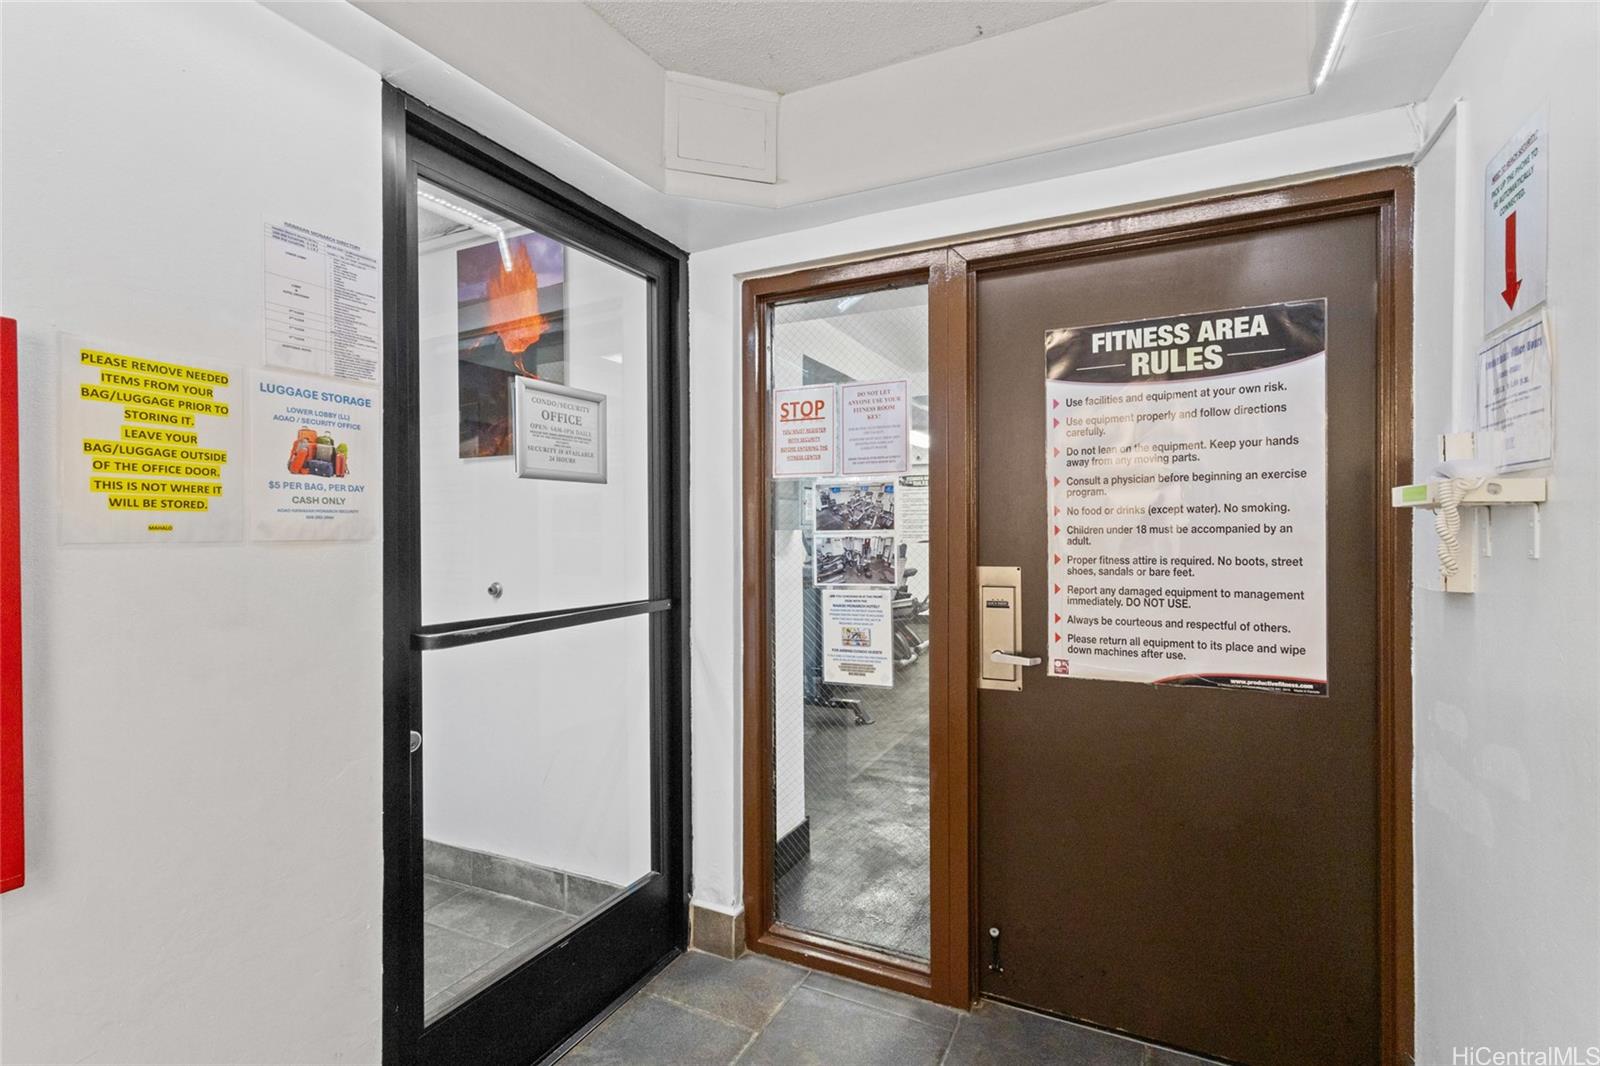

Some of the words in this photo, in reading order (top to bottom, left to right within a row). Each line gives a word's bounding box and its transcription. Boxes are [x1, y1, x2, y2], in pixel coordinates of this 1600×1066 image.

[1092, 323, 1190, 353] FITNESS
[1198, 314, 1269, 342] AREA
[81, 352, 128, 368] PLEASE
[131, 361, 183, 377] REMOVE
[186, 370, 229, 384] NEEDED
[1131, 345, 1223, 376] RULES
[101, 373, 141, 387] ITEMS
[143, 379, 179, 392] FROM
[182, 385, 214, 397] YOUR
[81, 387, 175, 407] BAG/LUGGAGE
[178, 400, 212, 412] PRIOR
[213, 405, 229, 415] TO
[260, 383, 319, 400] LUGGAGE
[321, 392, 371, 407] STORAGE
[1066, 398, 1083, 408] Use
[1084, 395, 1124, 407] facilities
[1125, 392, 1144, 403] and
[1146, 389, 1198, 402] equipment
[1200, 388, 1211, 397] at
[1213, 387, 1236, 398] your
[1238, 385, 1261, 394] own
[1264, 381, 1287, 392] risk.
[531, 397, 589, 412] CONDO/SECURITY
[780, 400, 825, 418] STOP
[124, 410, 178, 424] STORING
[181, 416, 194, 426] IT.
[286, 407, 314, 416] LOWER
[314, 410, 337, 419] LOBBY
[541, 410, 582, 426] OFFICE
[273, 414, 295, 422] AOAO
[300, 417, 336, 427] SECURITY
[337, 422, 361, 430] OFFICE
[124, 429, 162, 441] LEAVE
[165, 433, 198, 444] YOUR
[84, 442, 177, 458] BAG/LUGGAGE
[180, 450, 227, 462] OUTSIDE
[92, 460, 110, 470] OF
[113, 461, 138, 472] THE
[141, 464, 182, 474] OFFICE
[185, 466, 220, 477] DOOR.
[1066, 476, 1101, 486] Consult
[1103, 477, 1109, 485] a
[1111, 474, 1156, 486] physician
[1158, 473, 1190, 483] before
[1192, 471, 1242, 483] beginning
[1245, 472, 1258, 480] an
[1261, 469, 1307, 479] exercise
[93, 480, 123, 490] THIS
[127, 482, 138, 491] IS
[141, 482, 168, 492] NOT
[170, 484, 210, 494] WHERE
[213, 486, 222, 494] IT
[268, 480, 281, 490] $5
[283, 481, 302, 490] PER
[304, 482, 327, 492] BAG,
[328, 484, 347, 492] PER
[347, 484, 365, 493] DAY
[108, 498, 140, 508] WILL
[143, 499, 157, 508] BE
[160, 499, 208, 509] STORED.
[292, 496, 320, 504] CASH
[321, 497, 346, 505] ONLY
[1066, 525, 1104, 535] Children
[1106, 525, 1134, 534] under
[1136, 524, 1147, 534] 18
[1149, 525, 1173, 534] must
[1176, 525, 1189, 534] be
[1191, 524, 1261, 535] accompanied
[1264, 523, 1277, 535] by
[1279, 525, 1293, 533] an
[1067, 536, 1091, 546] adult.
[1067, 555, 1097, 566] Proper
[1099, 555, 1131, 565] fitness
[1132, 556, 1157, 565] attire
[1160, 555, 1168, 566] is
[1170, 556, 1214, 567] required.
[1218, 556, 1232, 566] No
[1235, 556, 1268, 567] boots,
[1271, 557, 1303, 567] street
[1067, 567, 1096, 576] shoes,
[1098, 566, 1134, 576] sandals
[1136, 568, 1147, 576] or
[1149, 567, 1171, 576] bare
[1172, 567, 1195, 577] feet.
[1067, 585, 1099, 596] Report
[1098, 587, 1116, 598] any
[1118, 586, 1164, 599] damaged
[1164, 588, 1218, 600] equipment
[1220, 589, 1231, 598] to
[1234, 591, 1304, 601] management
[1067, 597, 1123, 608] immediately.
[1126, 597, 1141, 607] DO
[1143, 598, 1165, 608] NOT
[1167, 598, 1191, 609] USE.
[1067, 615, 1099, 626] Always
[1101, 616, 1113, 626] be
[1115, 618, 1163, 628] courteous
[1165, 619, 1183, 629] and
[1186, 621, 1237, 631] respectful
[1239, 621, 1251, 631] of
[1253, 622, 1291, 633] others.
[1067, 634, 1097, 646] Please
[1099, 636, 1127, 648] return
[1129, 636, 1141, 646] all
[1143, 638, 1195, 649] equipment
[1196, 640, 1207, 650] to
[1210, 640, 1223, 651] its
[1225, 642, 1254, 653] place
[1256, 644, 1277, 654] and
[1280, 644, 1306, 656] wipe
[1067, 646, 1092, 654] down
[1094, 647, 1139, 657] machines
[1140, 648, 1165, 659] after
[1164, 651, 1186, 660] use.
